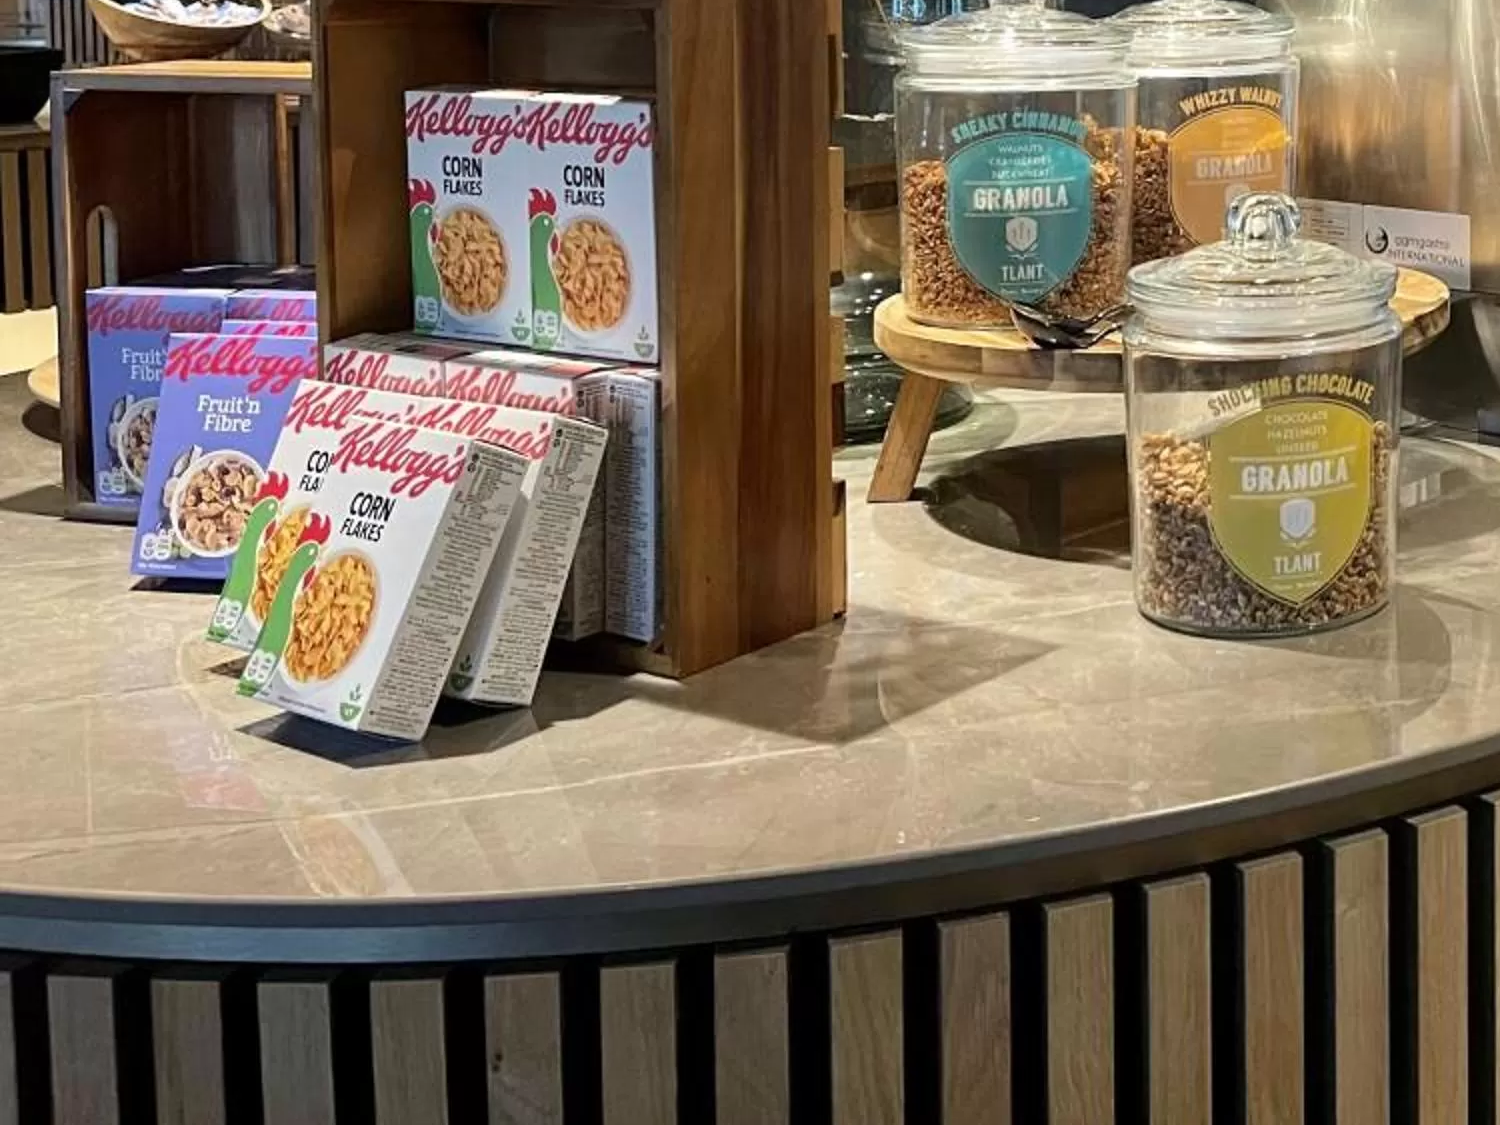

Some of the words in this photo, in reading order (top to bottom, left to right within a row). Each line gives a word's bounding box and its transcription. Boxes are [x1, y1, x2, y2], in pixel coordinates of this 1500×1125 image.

[1180, 87, 1237, 117] WHIZZY
[406, 93, 526, 155] Kellogg's
[525, 101, 654, 165] Kellogg's
[951, 112, 1008, 143] SNEAKY
[442, 156, 483, 178] CORN
[564, 165, 605, 188] CORN
[1195, 151, 1273, 179] GRANOLA
[443, 178, 483, 196] FLAKES
[565, 190, 605, 207] FLAKES
[973, 184, 1069, 211] GRANOLA
[1001, 263, 1045, 282] TLANT
[121, 347, 168, 365] Fruit'
[164, 334, 318, 394] Kellogg's
[131, 364, 162, 381] Fibr
[1295, 373, 1375, 404] CHOCOLATE
[197, 394, 261, 414] Fruit'n
[204, 414, 251, 433] Fibre
[333, 423, 465, 497] Kellogg's
[1240, 455, 1349, 494] GRANOLA
[349, 492, 396, 522] CORN
[340, 518, 384, 542] FLAKES
[1273, 552, 1322, 574] TLANT
